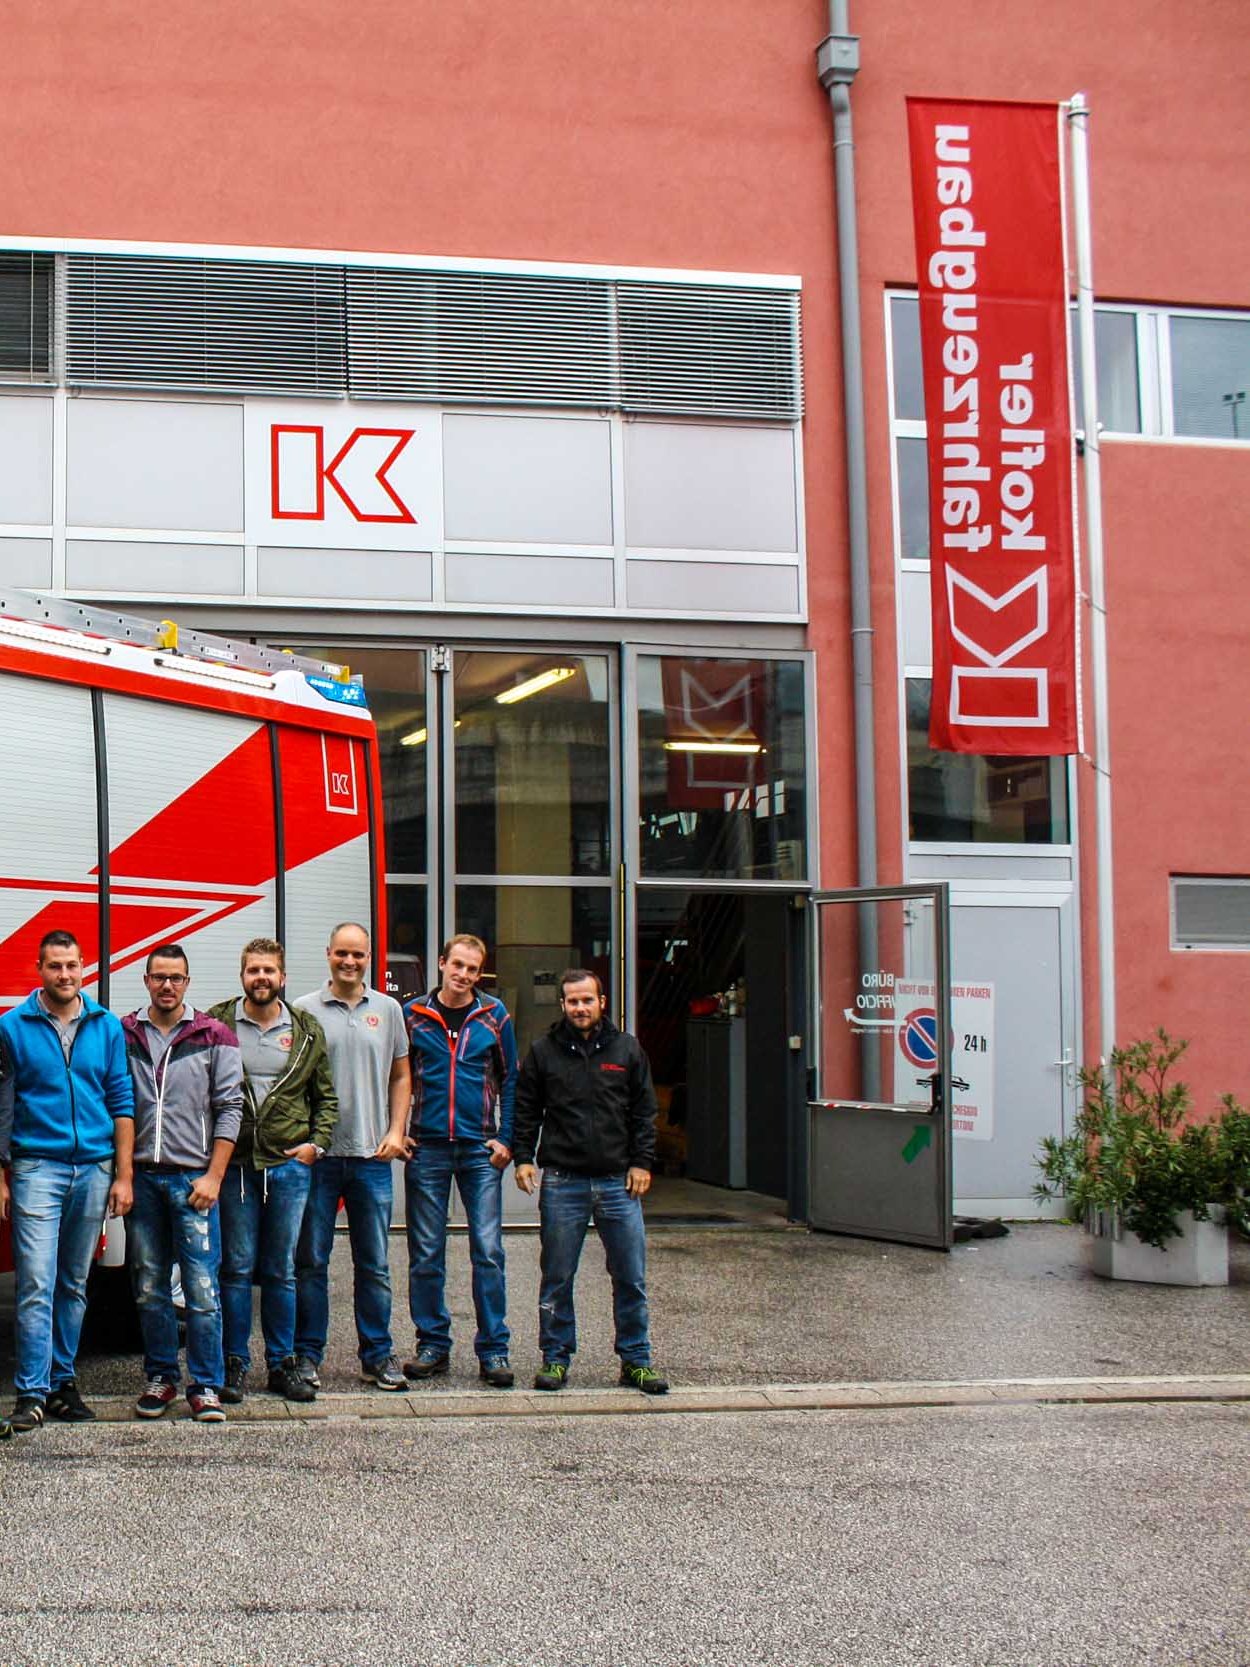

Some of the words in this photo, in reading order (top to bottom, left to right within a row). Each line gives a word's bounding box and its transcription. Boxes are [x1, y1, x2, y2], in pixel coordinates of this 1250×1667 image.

[271, 424, 418, 524] K
[964, 1034, 978, 1052] 24
[980, 1035, 987, 1053] h
